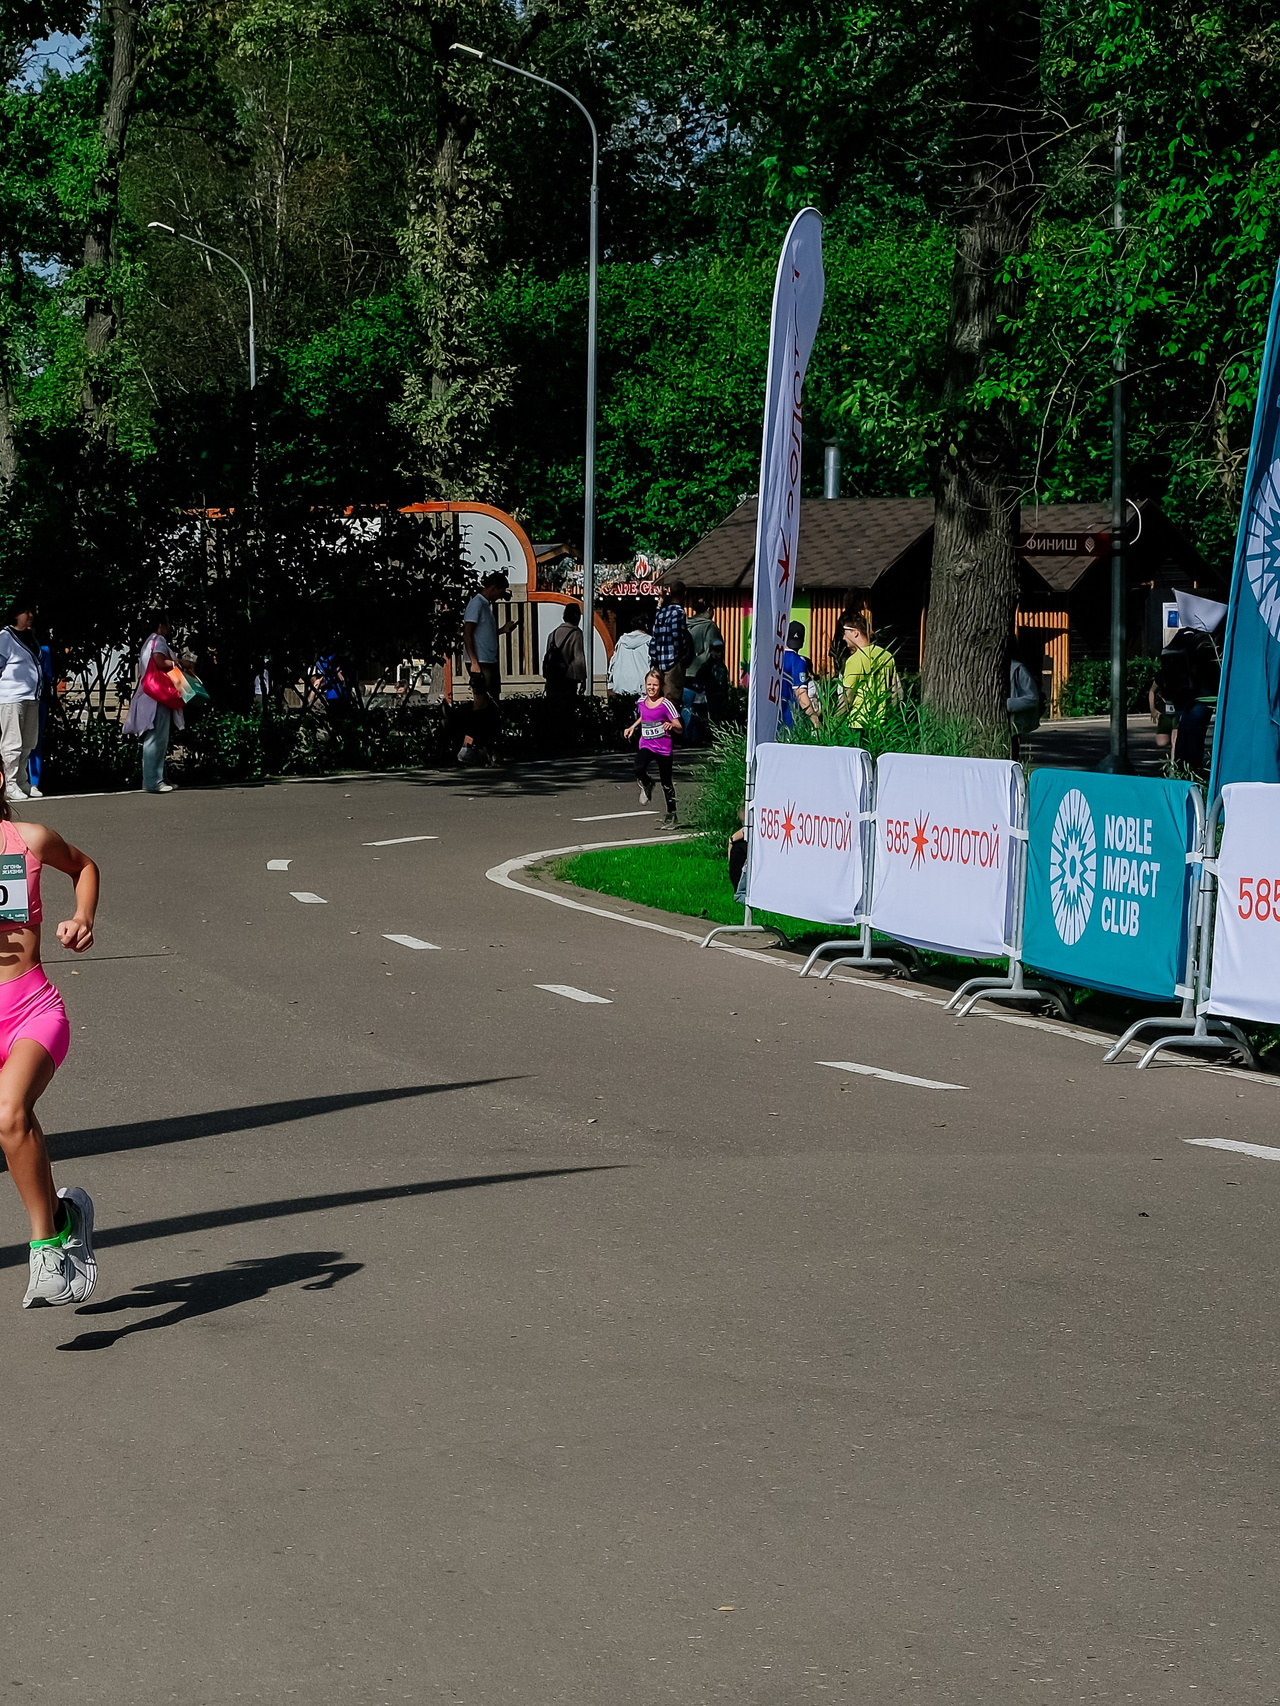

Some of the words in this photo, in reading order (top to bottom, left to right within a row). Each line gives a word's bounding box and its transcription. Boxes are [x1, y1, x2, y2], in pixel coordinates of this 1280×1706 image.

[1026, 539, 1077, 550] ФИНИШ
[760, 808, 780, 841] 585
[796, 811, 852, 852] ЗОЛОТОЙ
[886, 819, 910, 855] 585
[930, 823, 1000, 869] ЗОЛОТОЙ
[1104, 814, 1152, 855] NOBLE
[1102, 855, 1161, 898] IMPACT
[1101, 896, 1140, 937] CLUB
